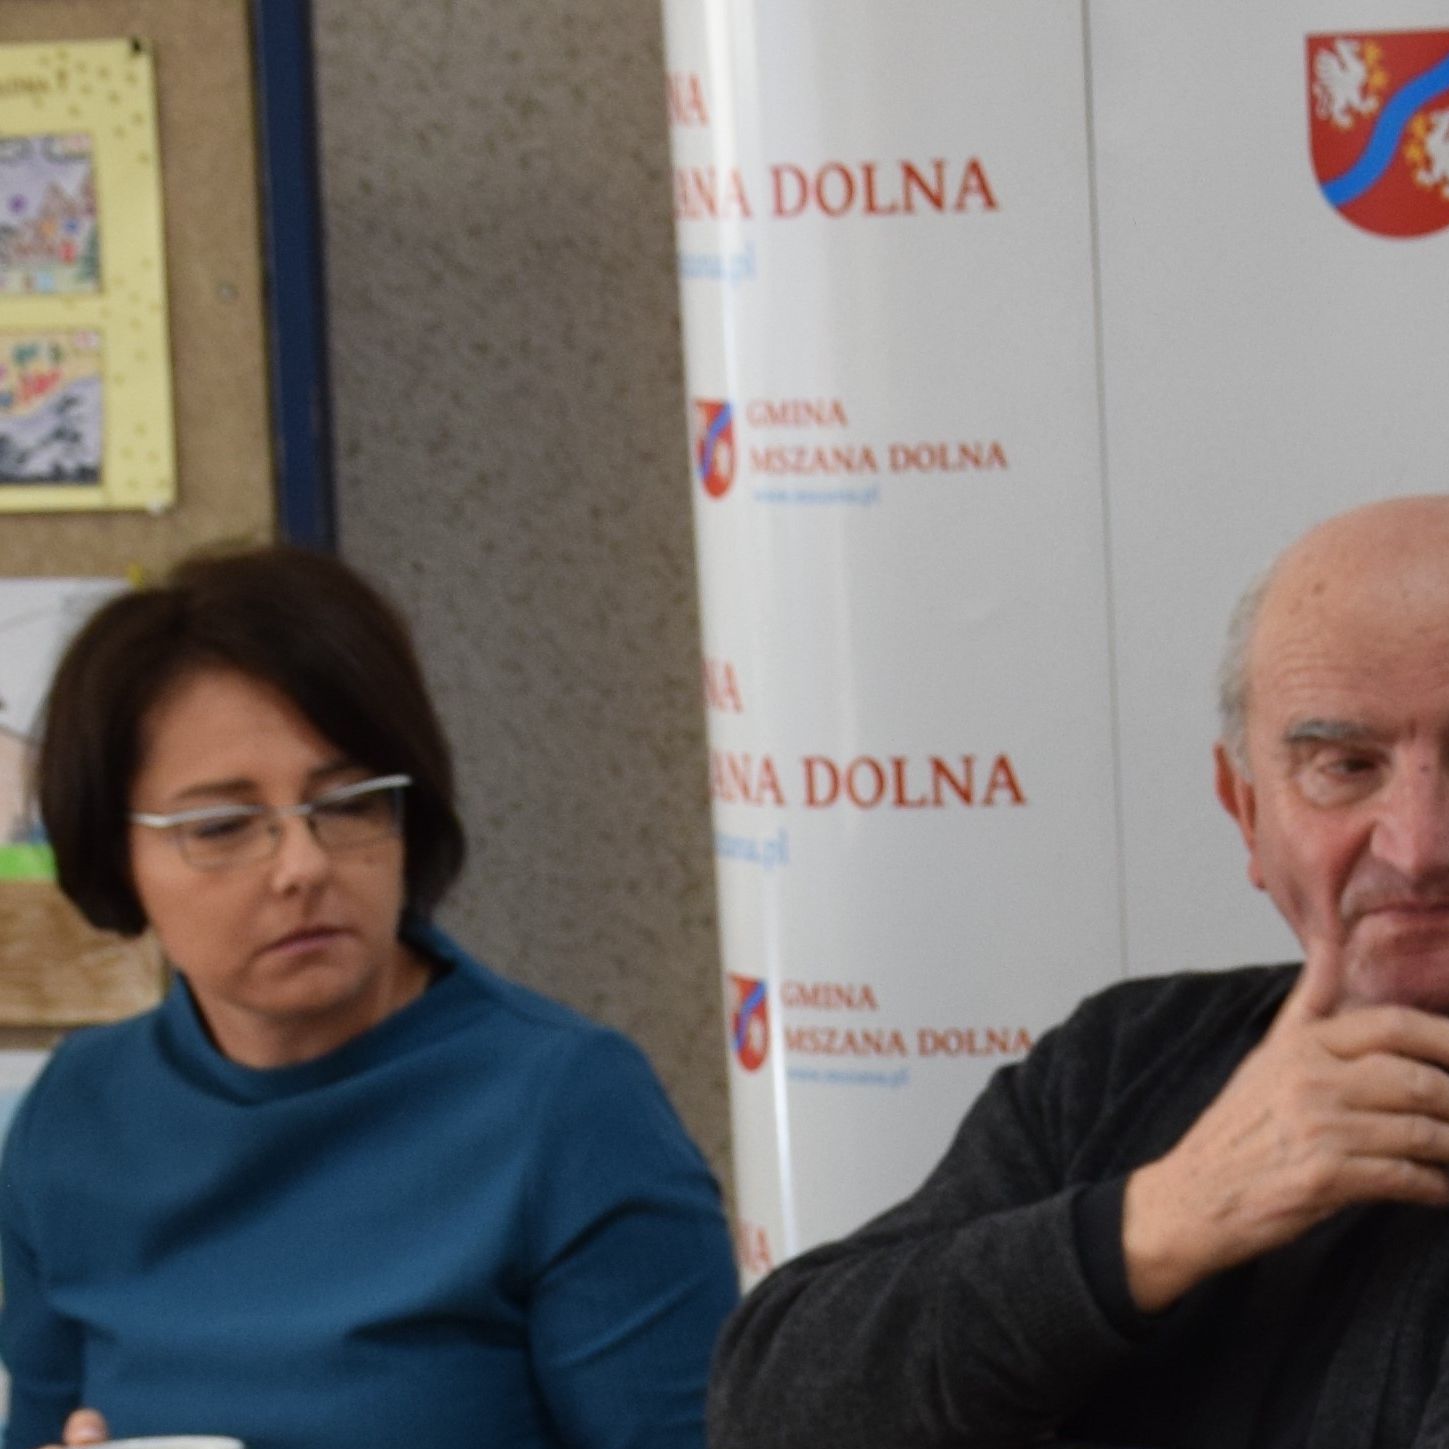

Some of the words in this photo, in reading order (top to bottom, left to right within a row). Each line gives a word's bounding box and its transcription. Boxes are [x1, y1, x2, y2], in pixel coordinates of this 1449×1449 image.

[770, 156, 1000, 218] DOLNA
[887, 440, 1009, 473] DOLNA
[801, 752, 1028, 810] DOLNA
